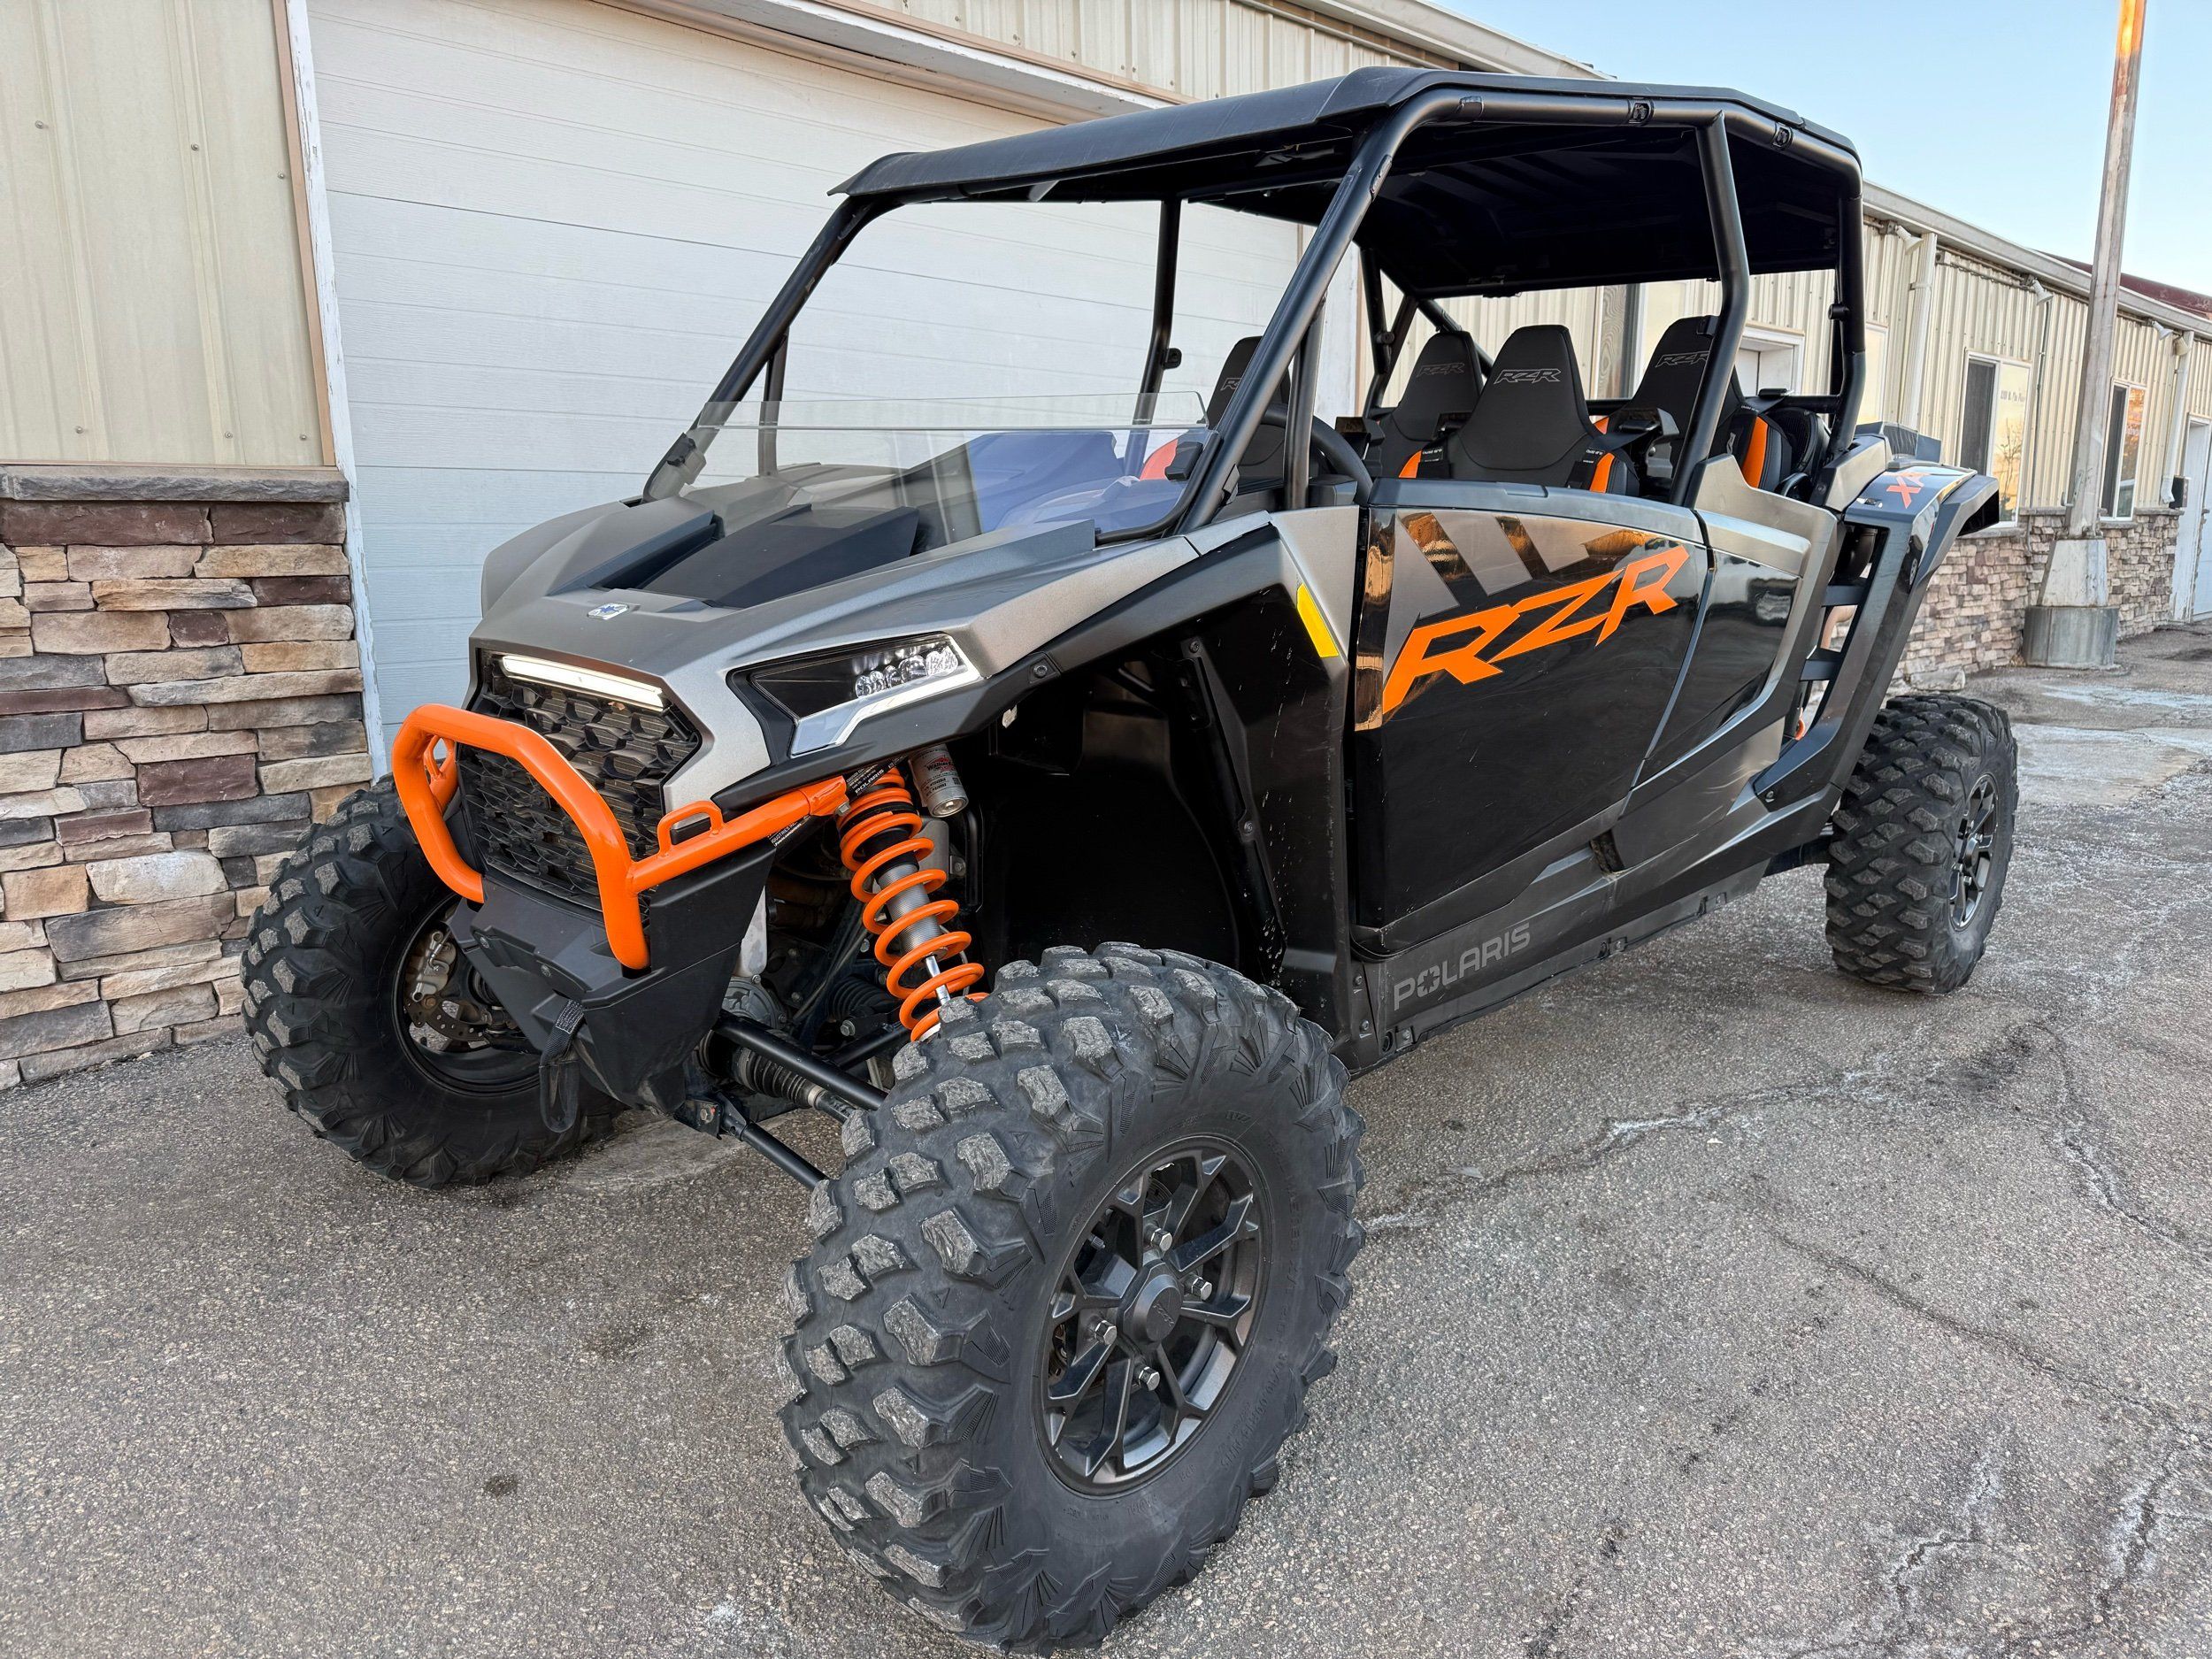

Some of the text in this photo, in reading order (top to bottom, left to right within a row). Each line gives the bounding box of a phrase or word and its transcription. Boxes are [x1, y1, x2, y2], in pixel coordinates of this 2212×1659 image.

[1656, 351, 1709, 367] RZR
[1416, 363, 1465, 378] RZR
[1494, 368, 1562, 385] RZR
[1382, 545, 1690, 714] RZR
[855, 769, 885, 794] POLARIS
[1394, 922, 1531, 1011] POLARIS
